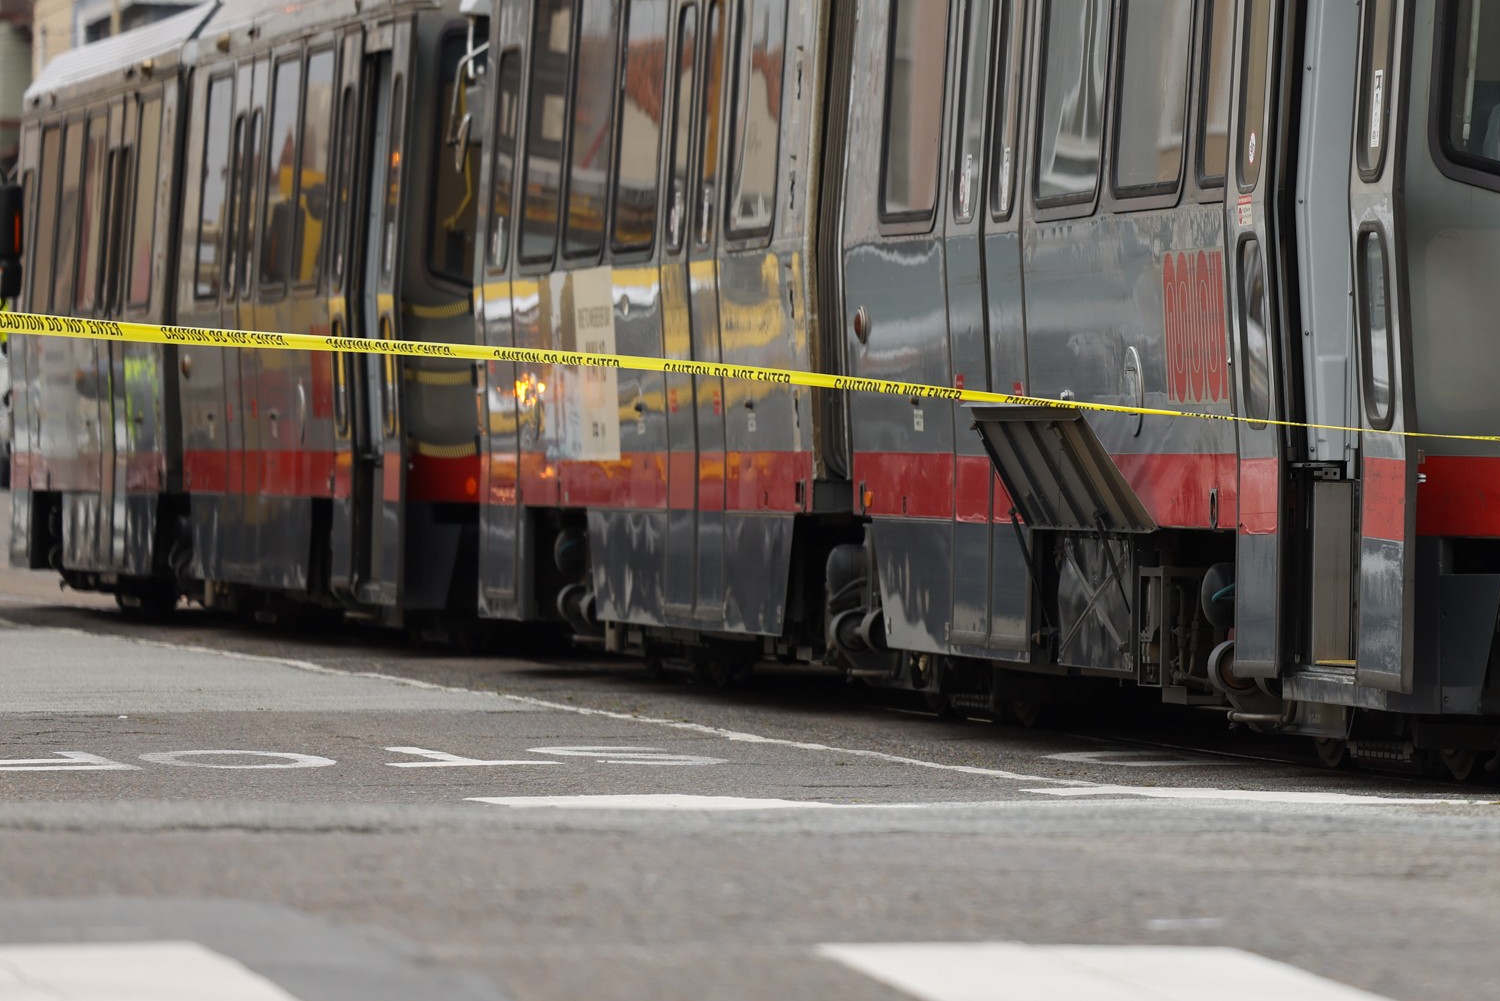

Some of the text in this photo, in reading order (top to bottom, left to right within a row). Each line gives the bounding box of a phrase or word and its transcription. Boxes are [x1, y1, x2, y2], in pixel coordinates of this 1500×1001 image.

[0, 313, 123, 336] CAUTION DO NOT ENTER
